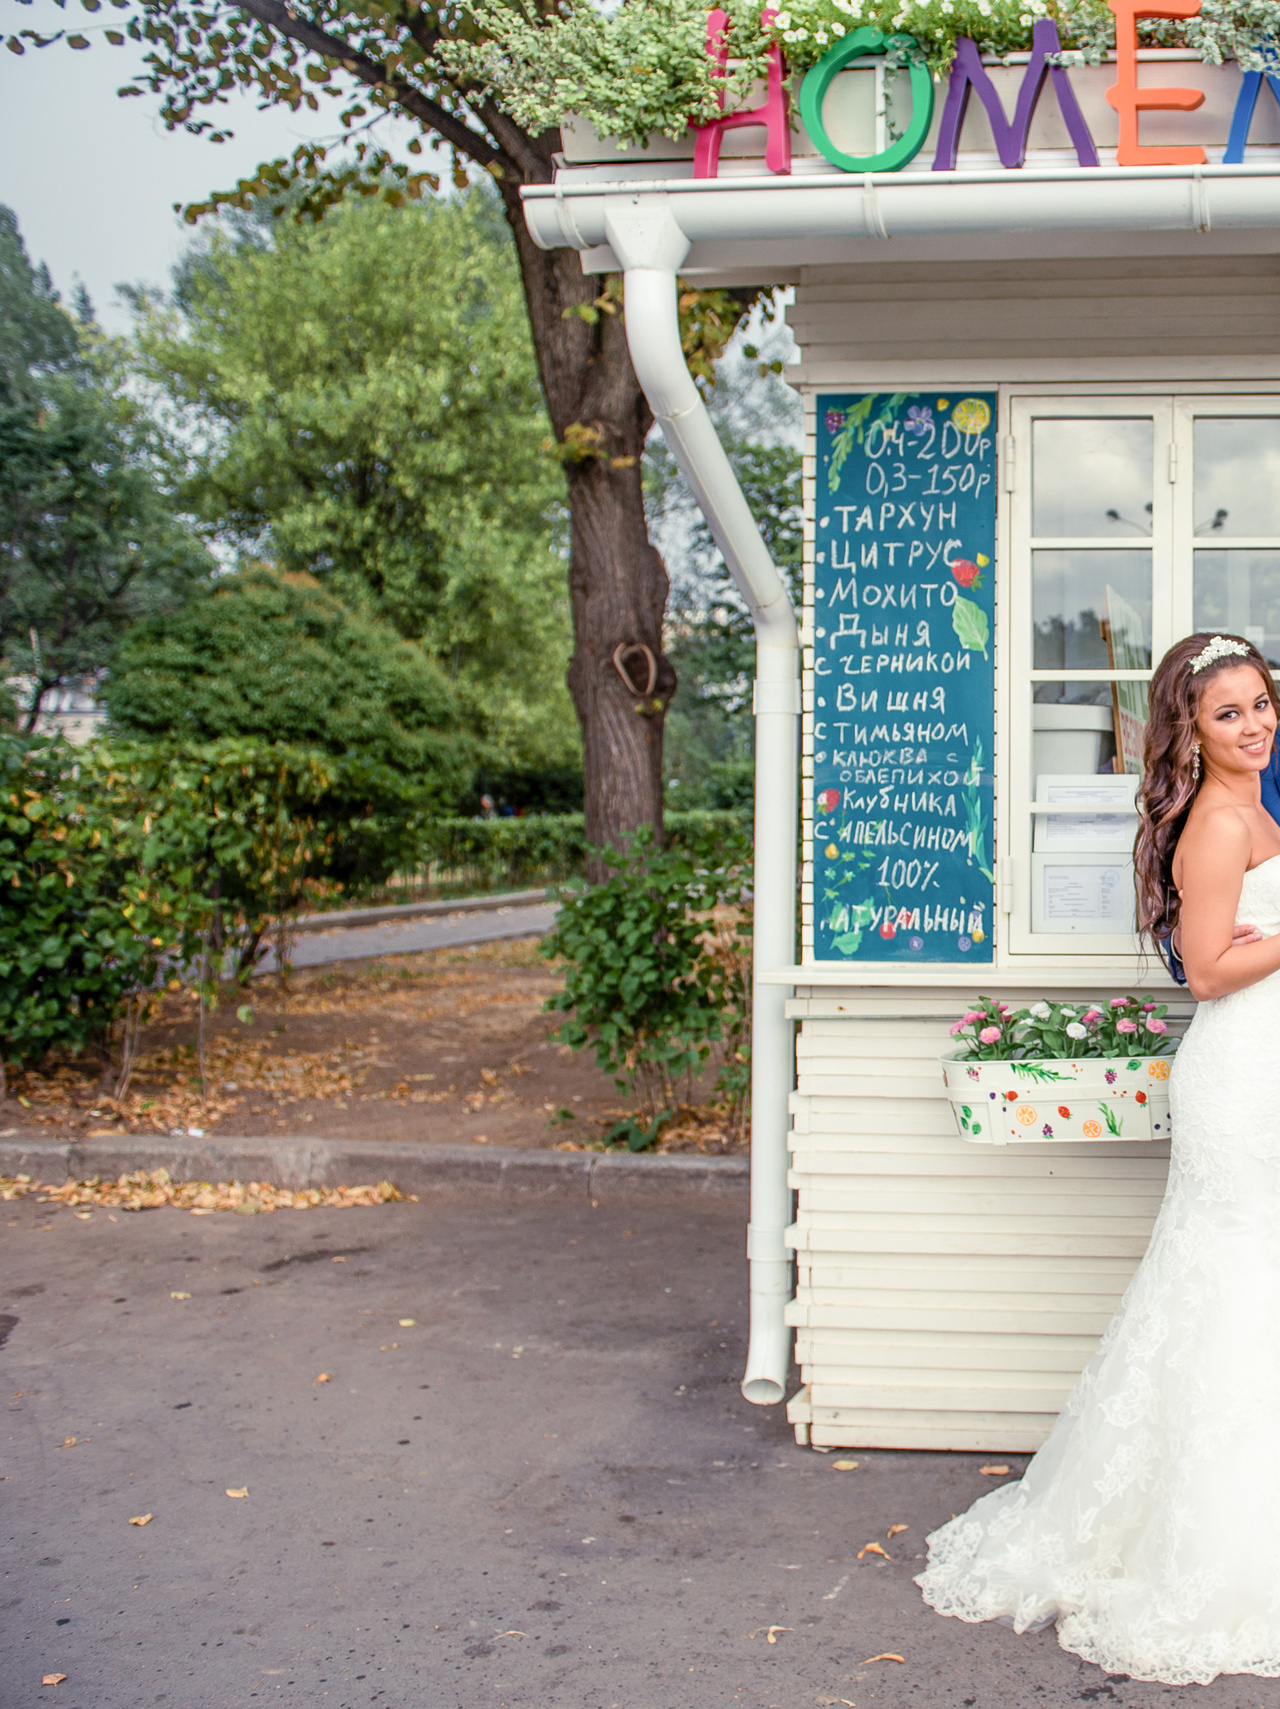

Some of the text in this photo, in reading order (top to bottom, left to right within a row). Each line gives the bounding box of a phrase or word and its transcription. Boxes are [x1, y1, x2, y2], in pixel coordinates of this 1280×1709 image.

[833, 501, 957, 533] ТАРХУН
[830, 538, 963, 574] ЦИТРУС
[832, 722, 969, 746] ТИМЬЯНОМ
[832, 747, 928, 767] КЛЮКВА
[838, 818, 974, 857] АПЕЛЬСИНОМ
[877, 855, 940, 891] 100%
